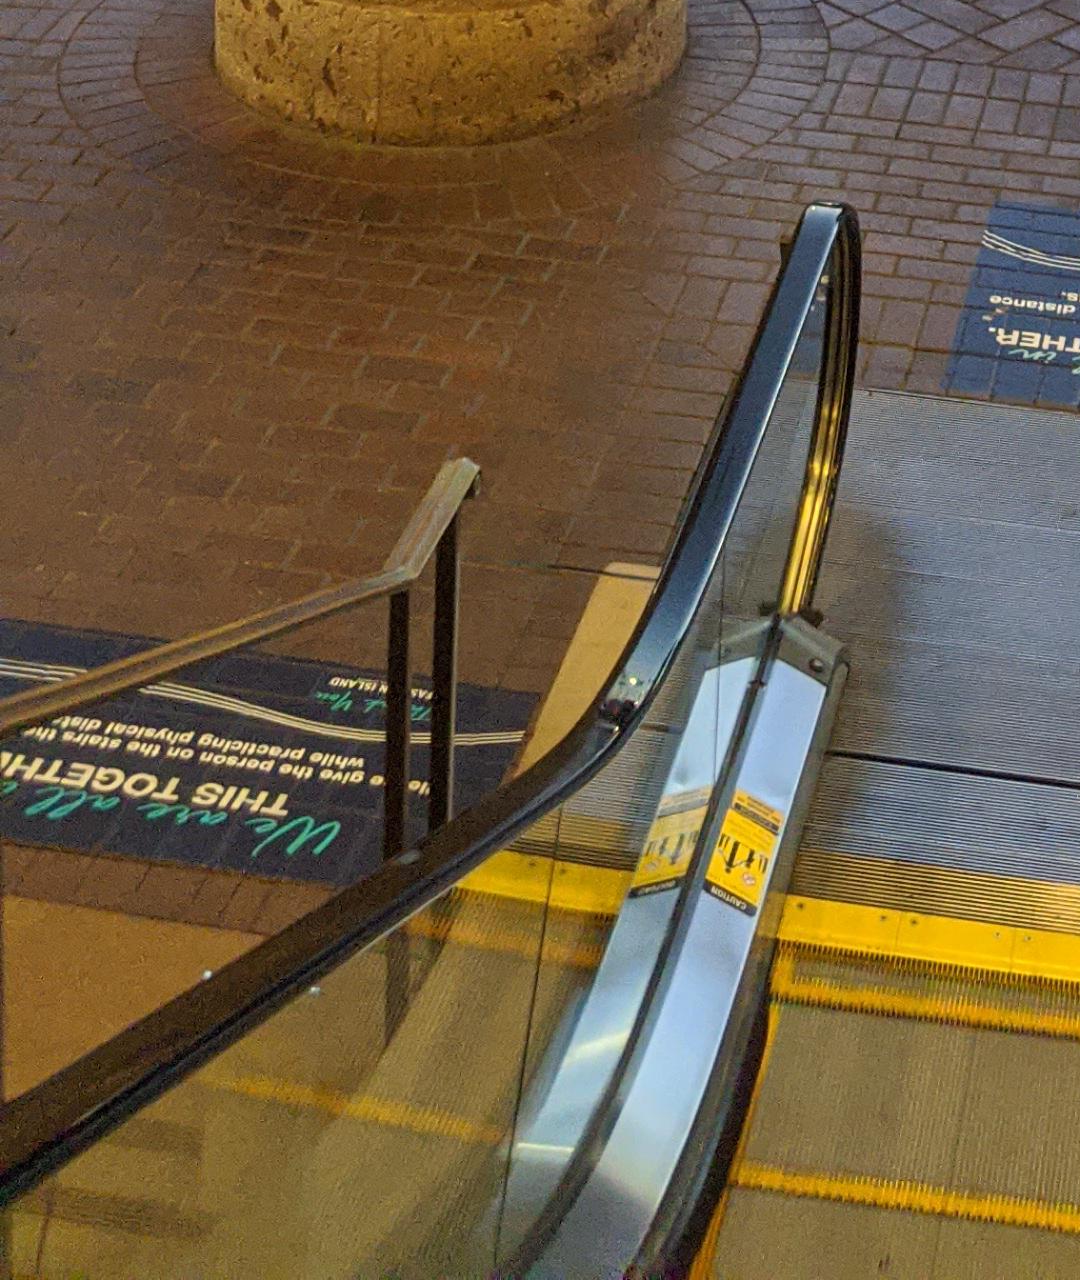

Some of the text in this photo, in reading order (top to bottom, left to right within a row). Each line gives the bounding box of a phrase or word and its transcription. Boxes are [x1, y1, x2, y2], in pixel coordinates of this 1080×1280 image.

[989, 294, 1076, 316] distance
[1008, 348, 1057, 364] in
[328, 677, 433, 701] FASN ISLAND
[62, 730, 122, 749] stairs
[105, 721, 195, 745] physical
[126, 740, 161, 757] the
[166, 744, 195, 761] on
[198, 732, 306, 761] practicing
[199, 750, 276, 773] person
[279, 762, 314, 780] the
[309, 751, 365, 769] while
[319, 769, 365, 784] give
[24, 786, 121, 820] all
[191, 782, 288, 817] THIS
[136, 802, 228, 826] are
[245, 816, 341, 858] We
[711, 884, 748, 911] CAUTION
